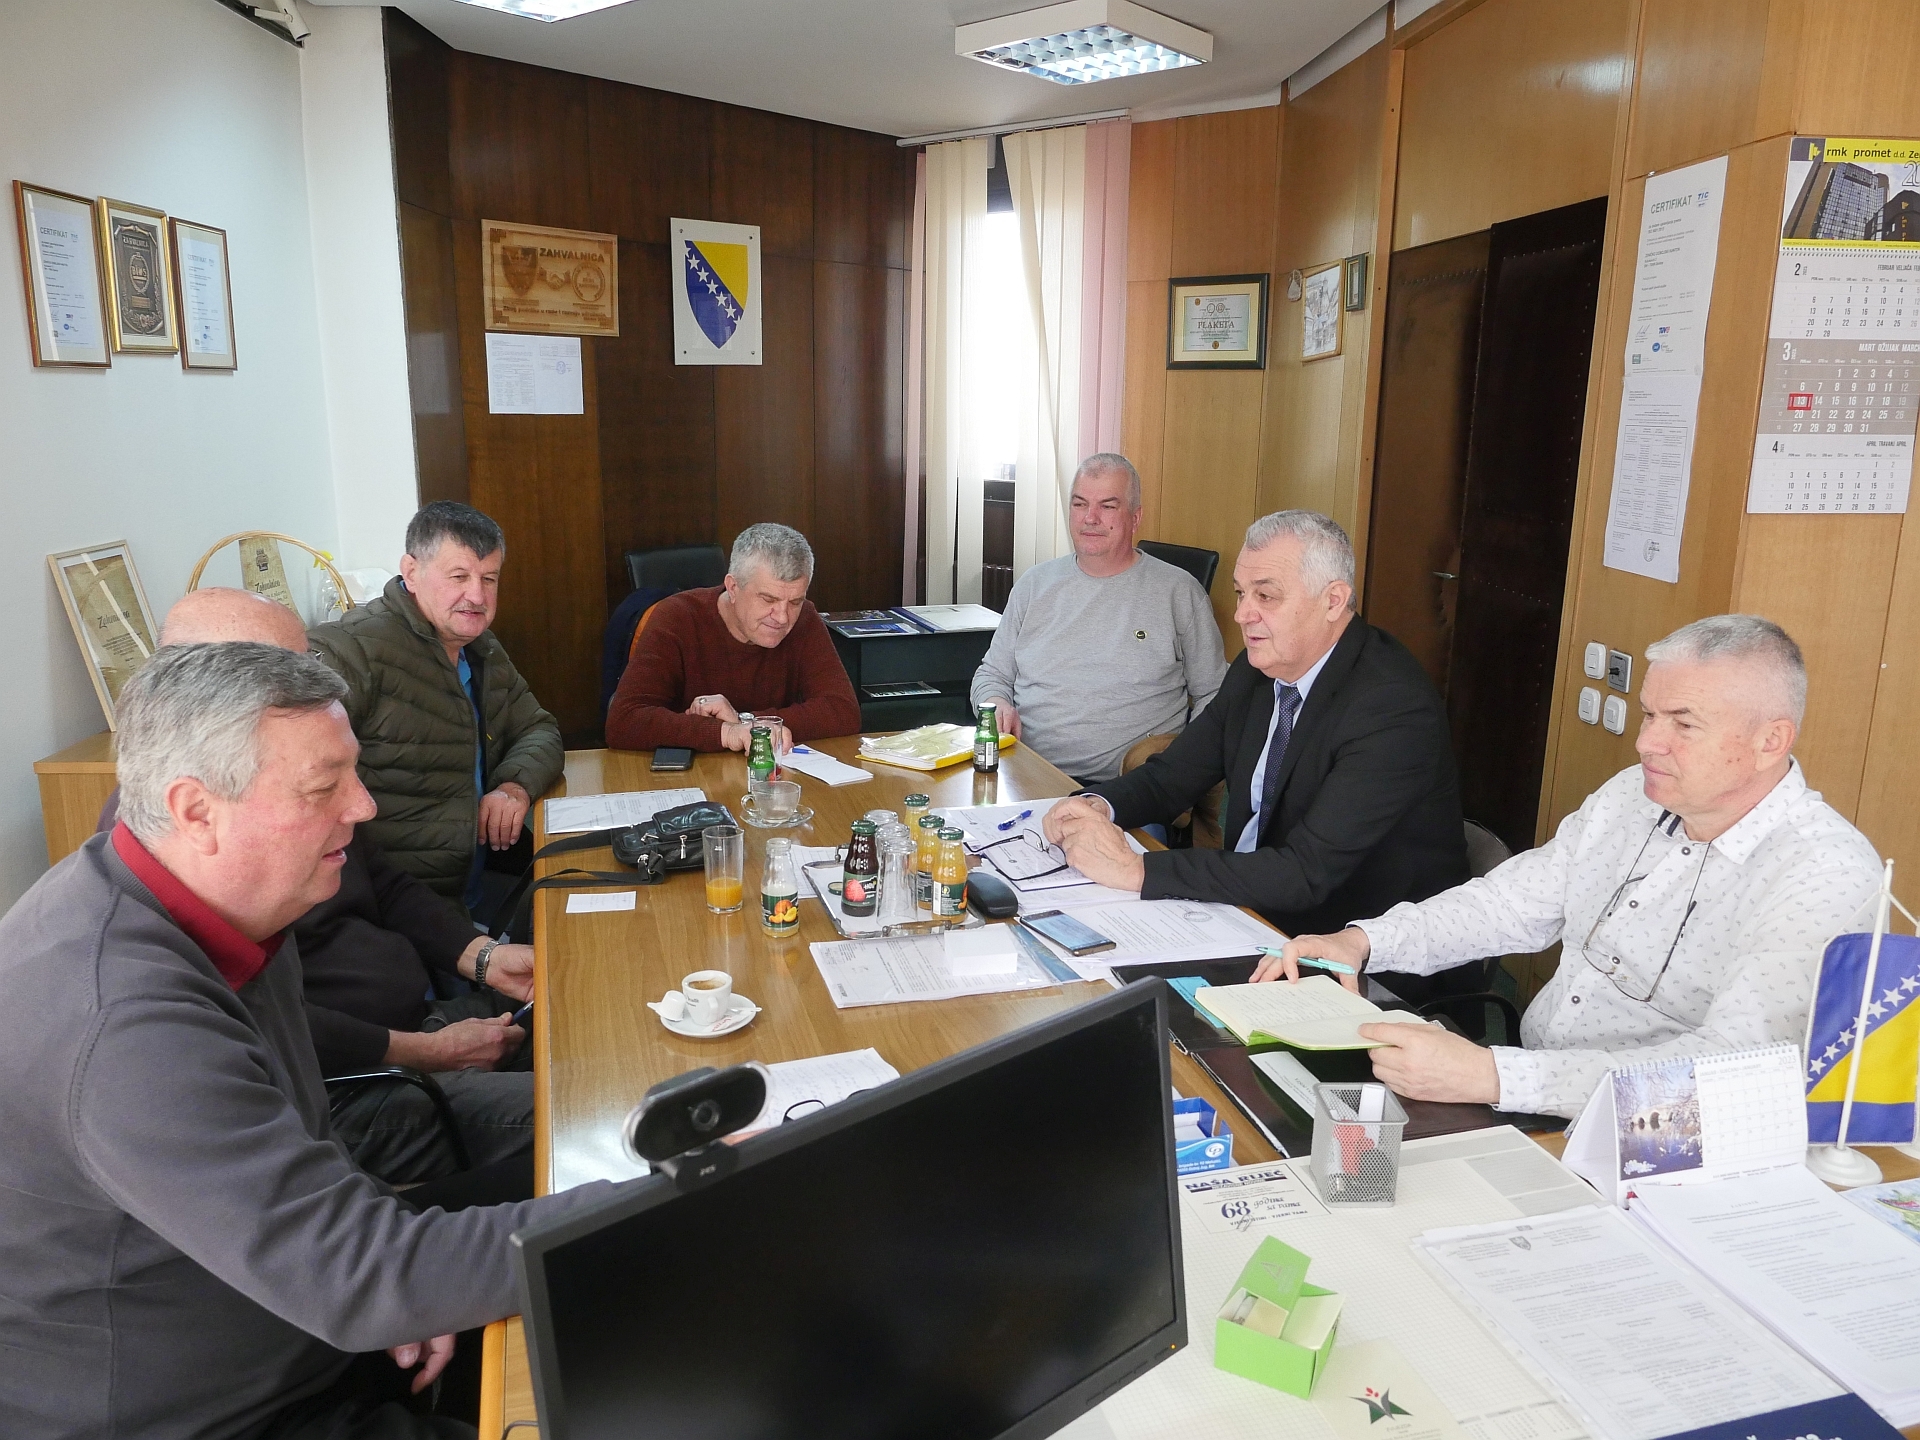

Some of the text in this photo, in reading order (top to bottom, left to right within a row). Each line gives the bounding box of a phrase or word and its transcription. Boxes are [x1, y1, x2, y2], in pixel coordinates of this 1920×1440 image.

[1826, 147, 1847, 157] rmk
[1853, 148, 1892, 159] promet
[1908, 150, 1920, 158] Ze
[1650, 195, 1693, 214] CERTIFIKAT
[40, 226, 68, 239] CERTIFIKAT
[539, 247, 605, 263] ZAHVALNICA
[1794, 263, 1801, 276] 2
[1197, 320, 1235, 329] PLAKETA
[1782, 342, 1792, 361] 3
[1858, 343, 1877, 352] MART
[1877, 342, 1900, 352] OŽUJAK
[1837, 369, 1909, 378] 1 2 3 4 5
[1800, 382, 1909, 392] 6 7 8 9 10 11 12
[1796, 396, 1806, 405] 13
[1814, 396, 1823, 405] 14
[1831, 396, 1840, 405] 15
[1848, 396, 1857, 405] 16
[1865, 396, 1874, 406] 17
[1882, 397, 1891, 406] 18
[1794, 410, 1905, 420] 20 21 22 23 24 25 26
[1792, 423, 1869, 433] 27 28 29 30 31
[1772, 440, 1779, 453] 4
[1778, 1055, 1797, 1065] 2023
[1184, 1178, 1234, 1191] NAŠA
[1221, 1201, 1251, 1219] 68
